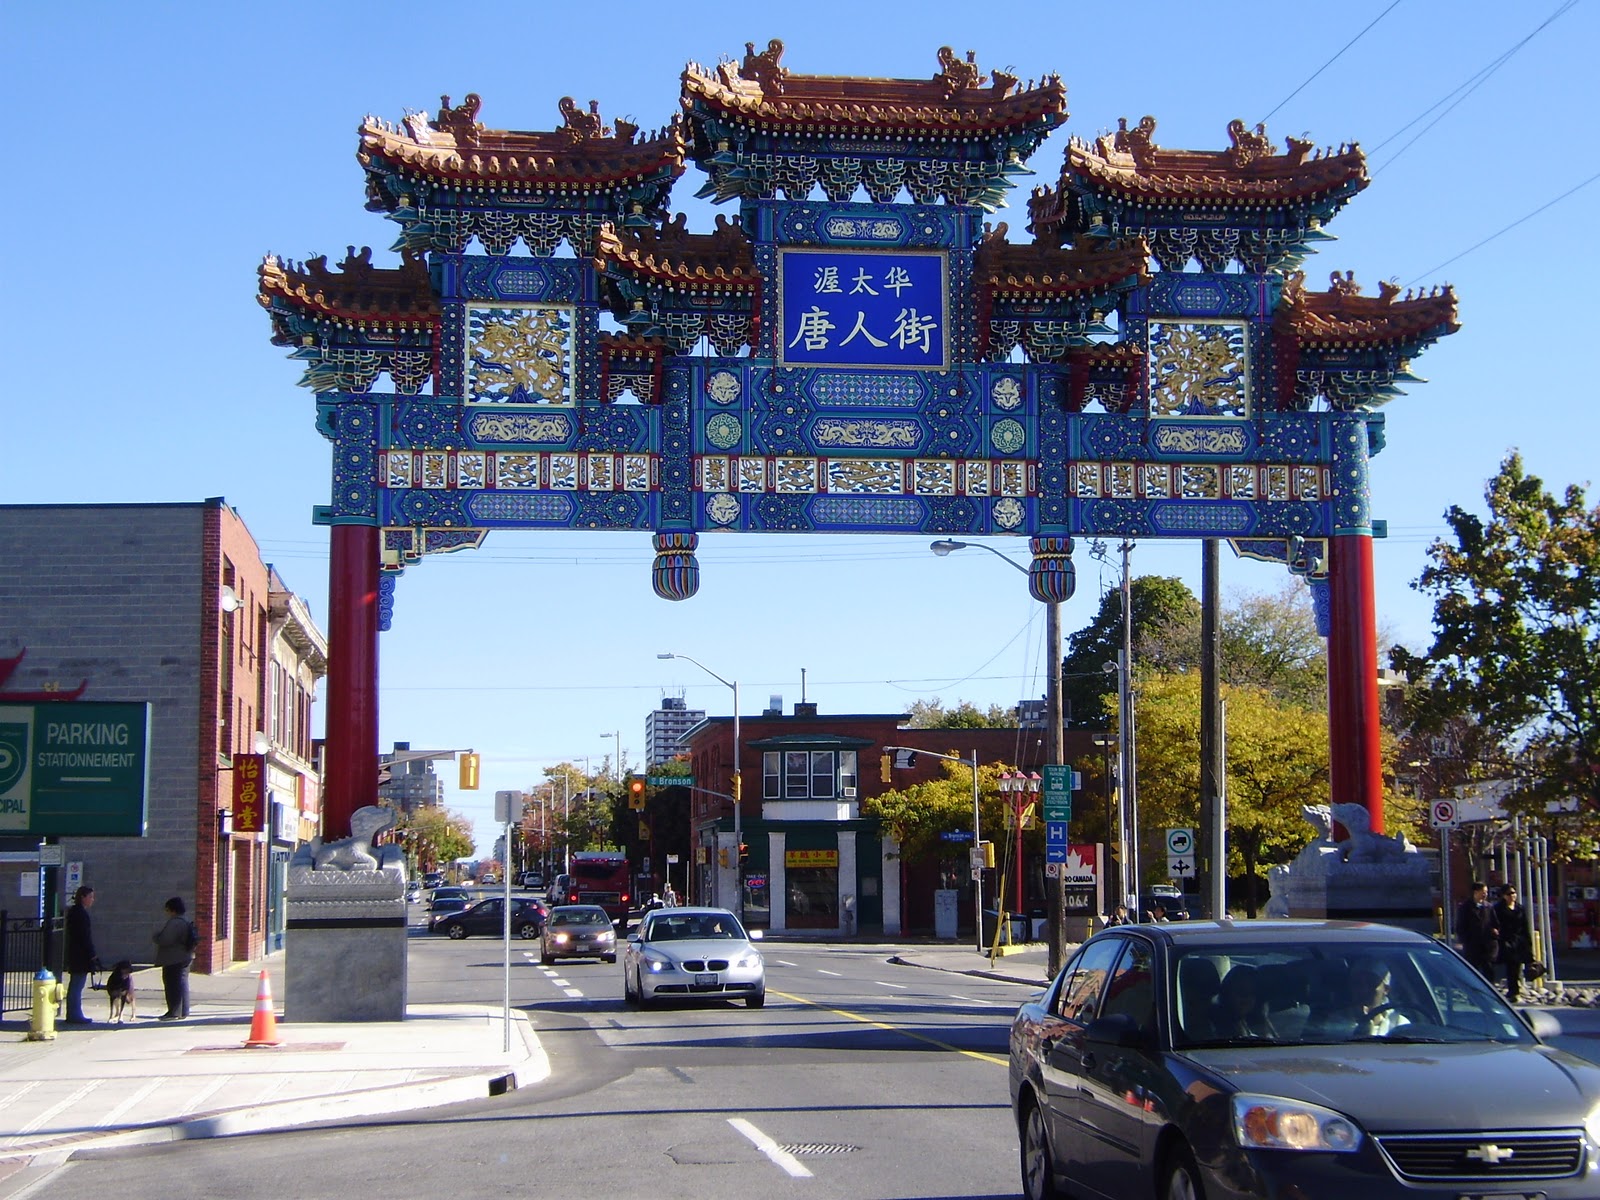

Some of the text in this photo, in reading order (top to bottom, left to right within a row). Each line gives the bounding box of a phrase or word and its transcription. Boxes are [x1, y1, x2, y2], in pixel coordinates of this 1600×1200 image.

[813, 266, 913, 298] 渥太华
[789, 305, 938, 354] 唐人街
[47, 723, 129, 746] PARKING
[38, 752, 136, 768] STATIONNEMENT
[659, 777, 692, 785] Bronson
[1050, 826, 1063, 840] H
